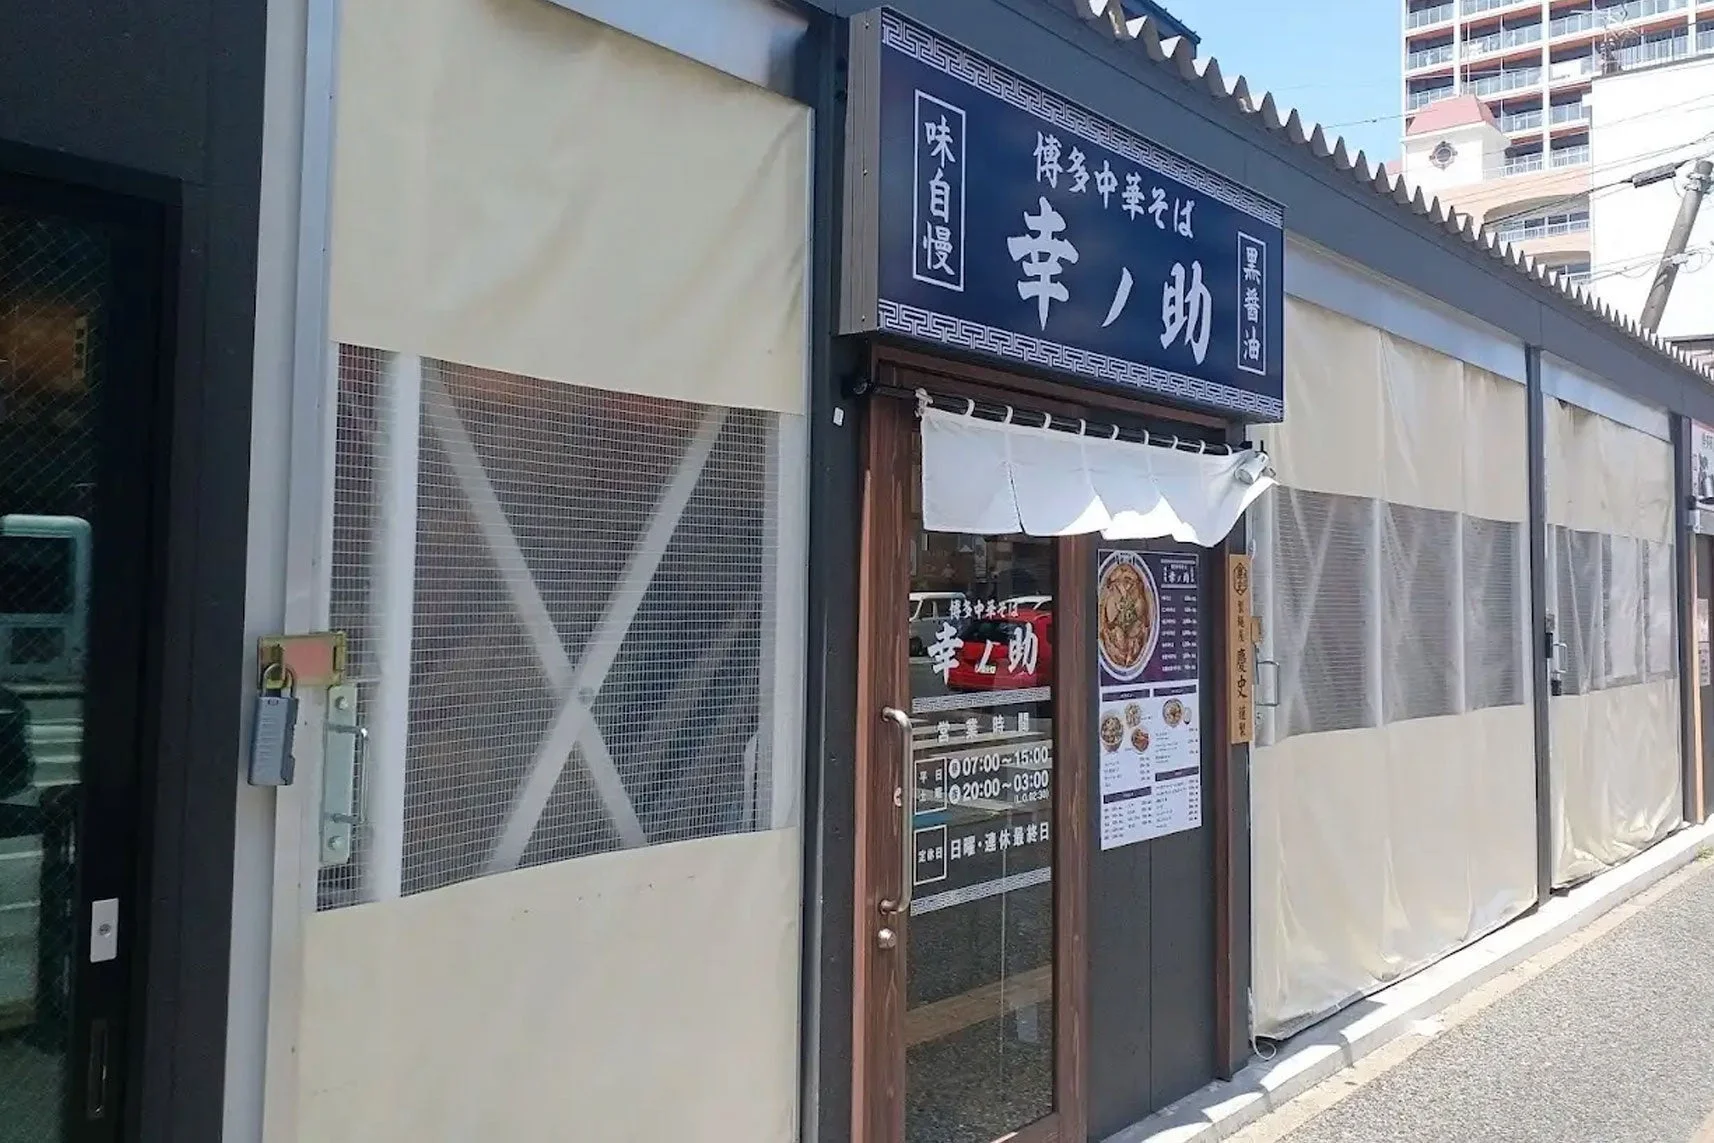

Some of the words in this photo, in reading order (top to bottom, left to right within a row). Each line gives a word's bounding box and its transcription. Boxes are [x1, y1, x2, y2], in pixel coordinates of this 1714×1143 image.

[922, 115, 956, 276] 味自慢
[1032, 130, 1195, 239] 博多中華そば
[1006, 196, 1213, 365] 幸ノ助
[1242, 246, 1262, 361] 黒醤油
[927, 621, 1039, 686] 幸ノ助
[949, 599, 1019, 621] 博多中華そば
[937, 712, 1030, 743] 営業時間
